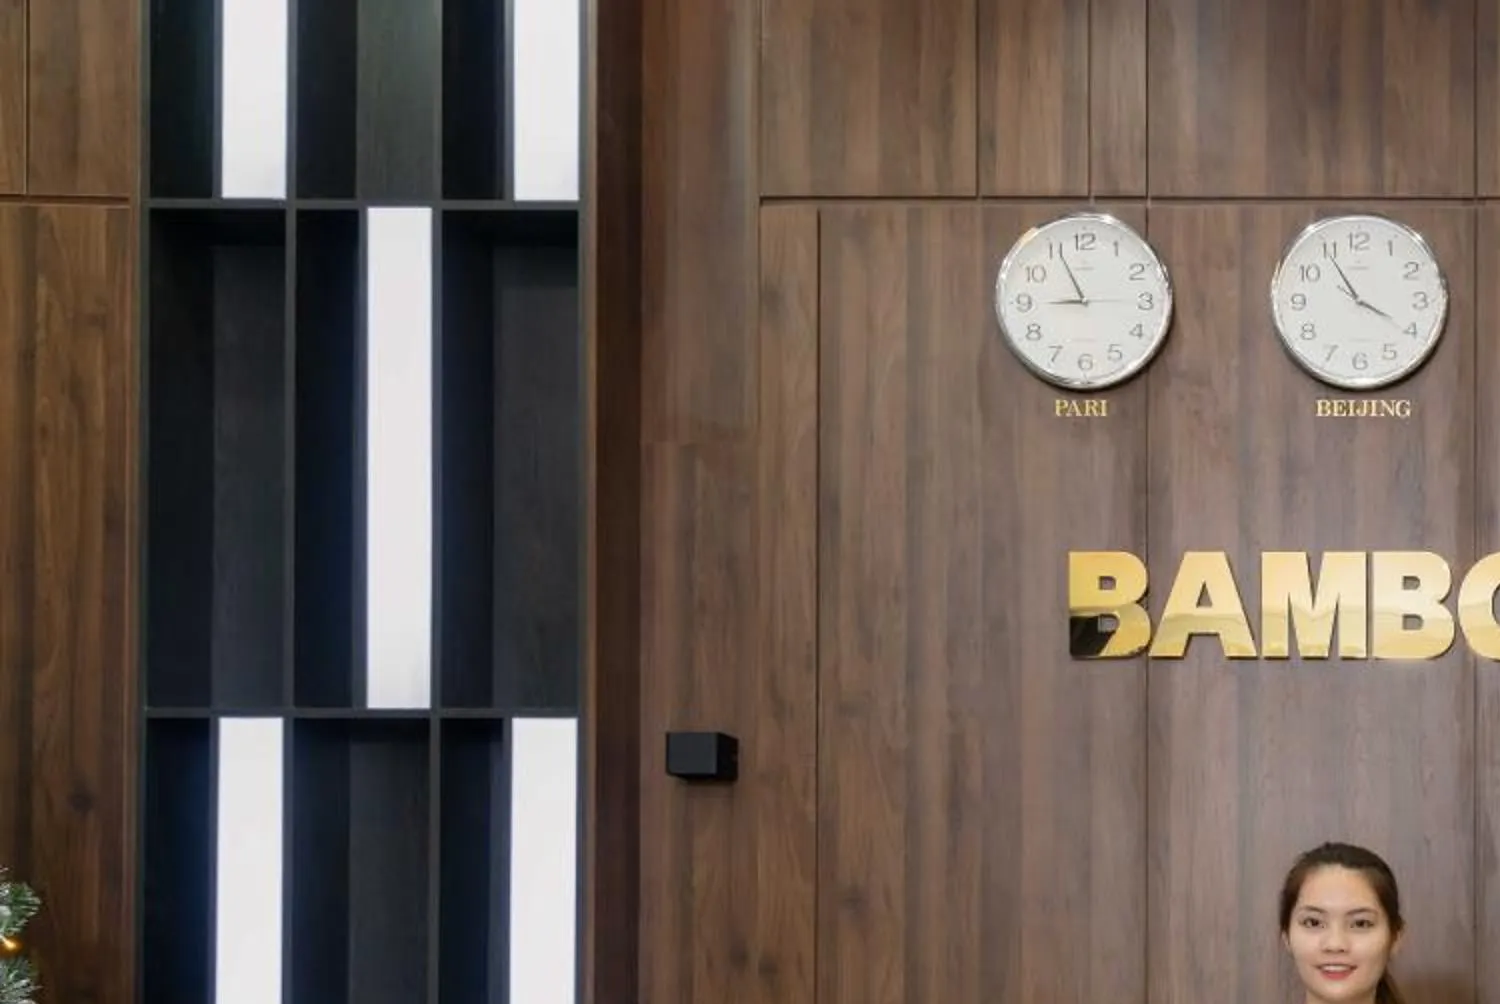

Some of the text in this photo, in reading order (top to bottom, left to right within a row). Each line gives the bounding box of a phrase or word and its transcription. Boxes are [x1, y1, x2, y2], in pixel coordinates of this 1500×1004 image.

[1075, 234, 1096, 250] 12
[1113, 240, 1119, 257] 1
[1350, 233, 1369, 250] 12
[1387, 240, 1393, 257] 1
[1050, 243, 1065, 260] 11
[1322, 242, 1337, 259] 11
[1027, 267, 1046, 282] 10
[1129, 264, 1144, 280] 2
[1300, 265, 1320, 281] 10
[1404, 262, 1419, 279] 2
[1017, 295, 1032, 312] 9
[1138, 292, 1154, 310] 3
[1291, 294, 1306, 310] 9
[1413, 292, 1428, 309] 3
[1026, 323, 1042, 340] 8
[1129, 323, 1144, 339] 4
[1300, 324, 1316, 340] 8
[1403, 322, 1418, 338] 4
[1049, 345, 1063, 363] 7
[1107, 343, 1123, 361] 5
[1325, 344, 1338, 361] 7
[1382, 343, 1397, 361] 5
[1078, 354, 1093, 369] 6
[1352, 354, 1367, 369] 6
[1054, 399, 1108, 417] PARI
[1315, 399, 1412, 418] BEIJING
